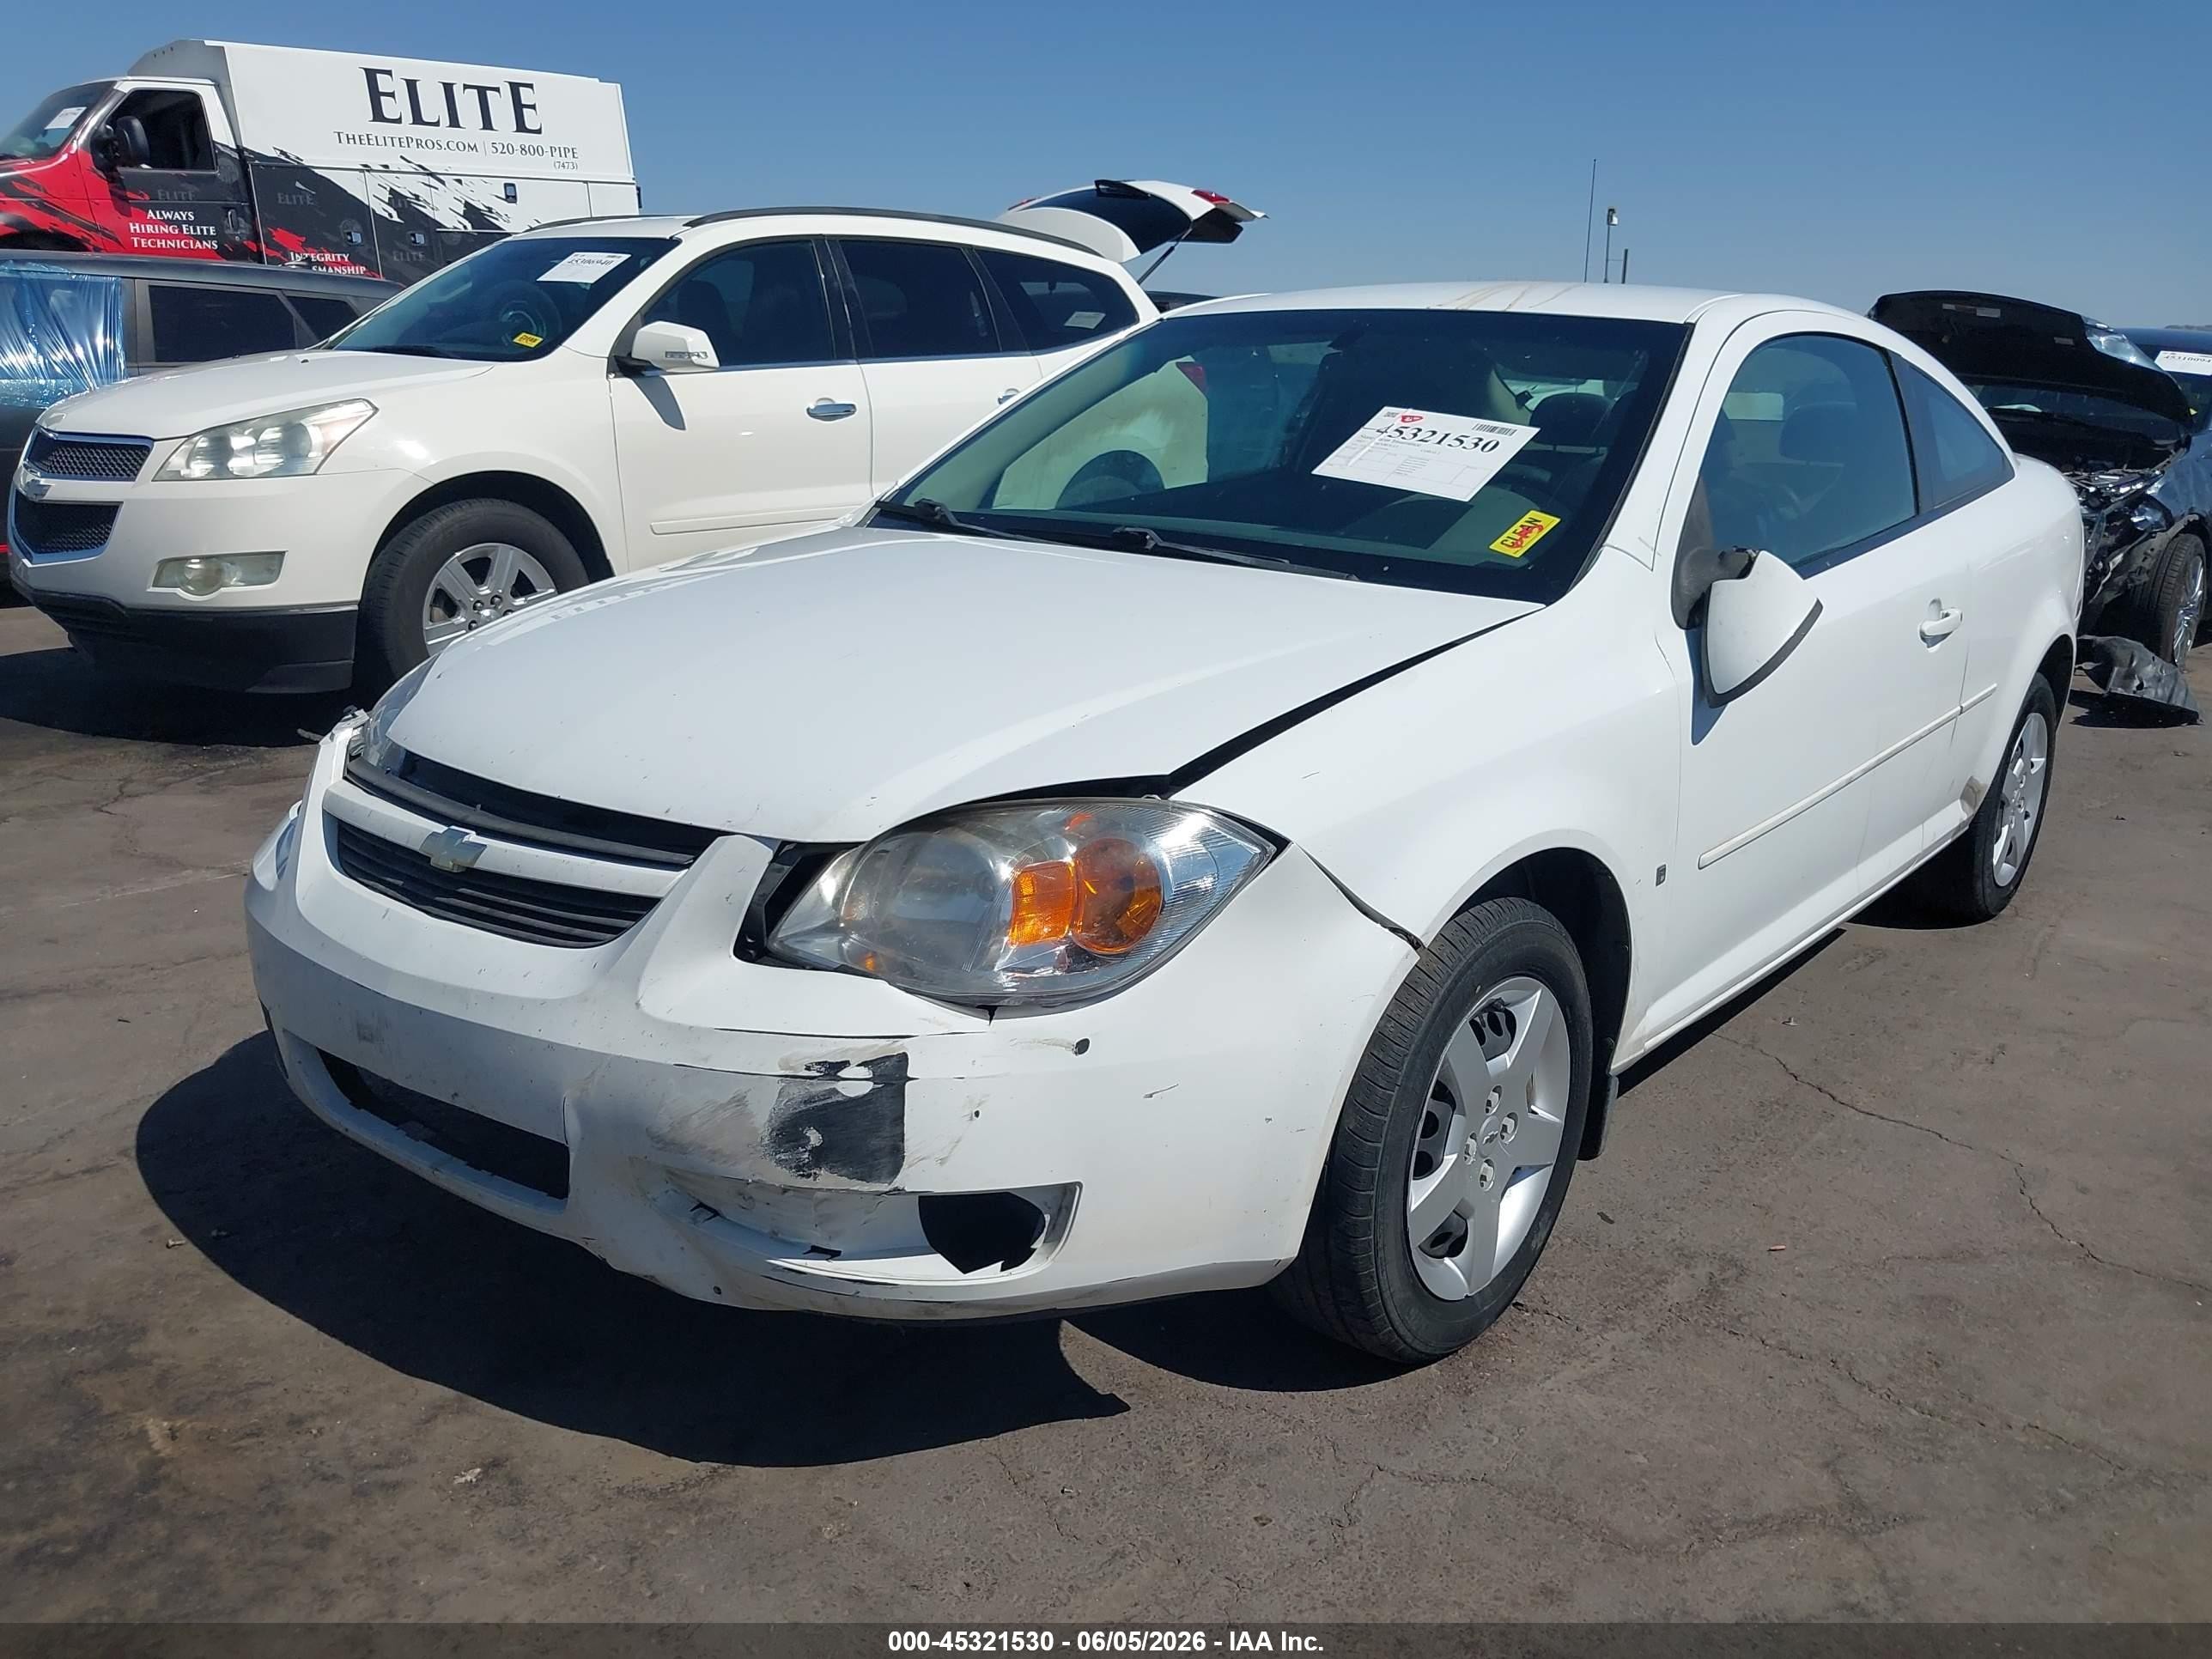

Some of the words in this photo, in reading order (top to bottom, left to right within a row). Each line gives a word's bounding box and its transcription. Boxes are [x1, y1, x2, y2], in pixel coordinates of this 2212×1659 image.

[358, 66, 543, 135] ELITE
[491, 142, 579, 159] 520-800-PIPE
[553, 161, 579, 170] (7473)
[147, 209, 194, 221] ALWAYS
[129, 222, 179, 235] HIRING
[182, 224, 217, 235] ELITE
[131, 237, 218, 250] TECHNICIANS
[1376, 423, 1500, 453] 45321530
